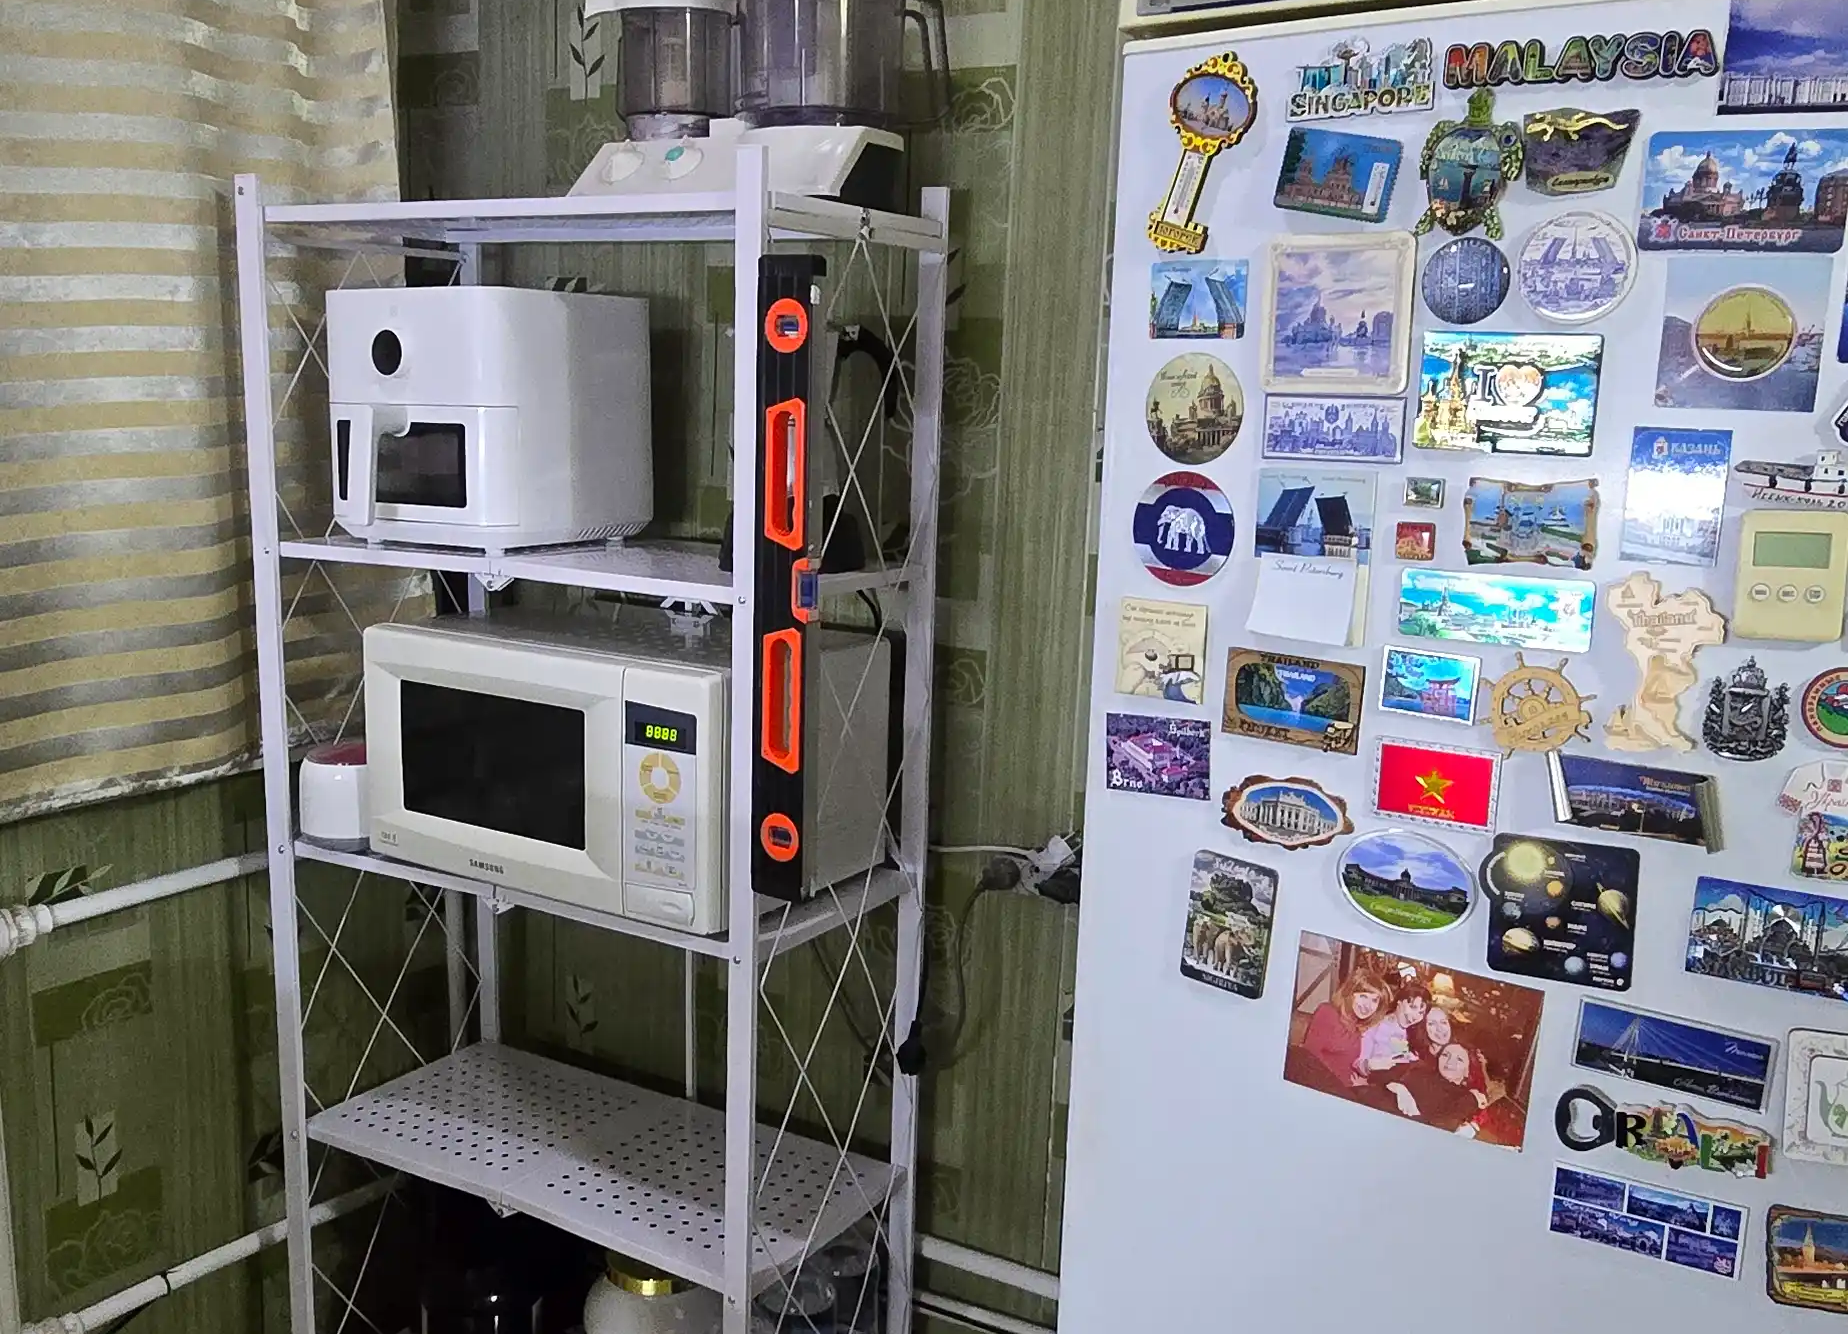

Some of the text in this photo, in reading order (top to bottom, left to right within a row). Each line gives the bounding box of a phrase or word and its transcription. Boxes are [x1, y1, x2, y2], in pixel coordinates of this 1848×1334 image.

[1443, 28, 1718, 90] MALAYSIA
[1289, 83, 1431, 118] SINGAPORE
[1677, 225, 1802, 246] Санкт-Петербург
[1475, 367, 1495, 403] I
[1670, 441, 1722, 456] КАЗАНЬ
[1260, 653, 1320, 669] THAILAND
[1110, 768, 1143, 789] Brno
[469, 858, 504, 874] SAMSUNG
